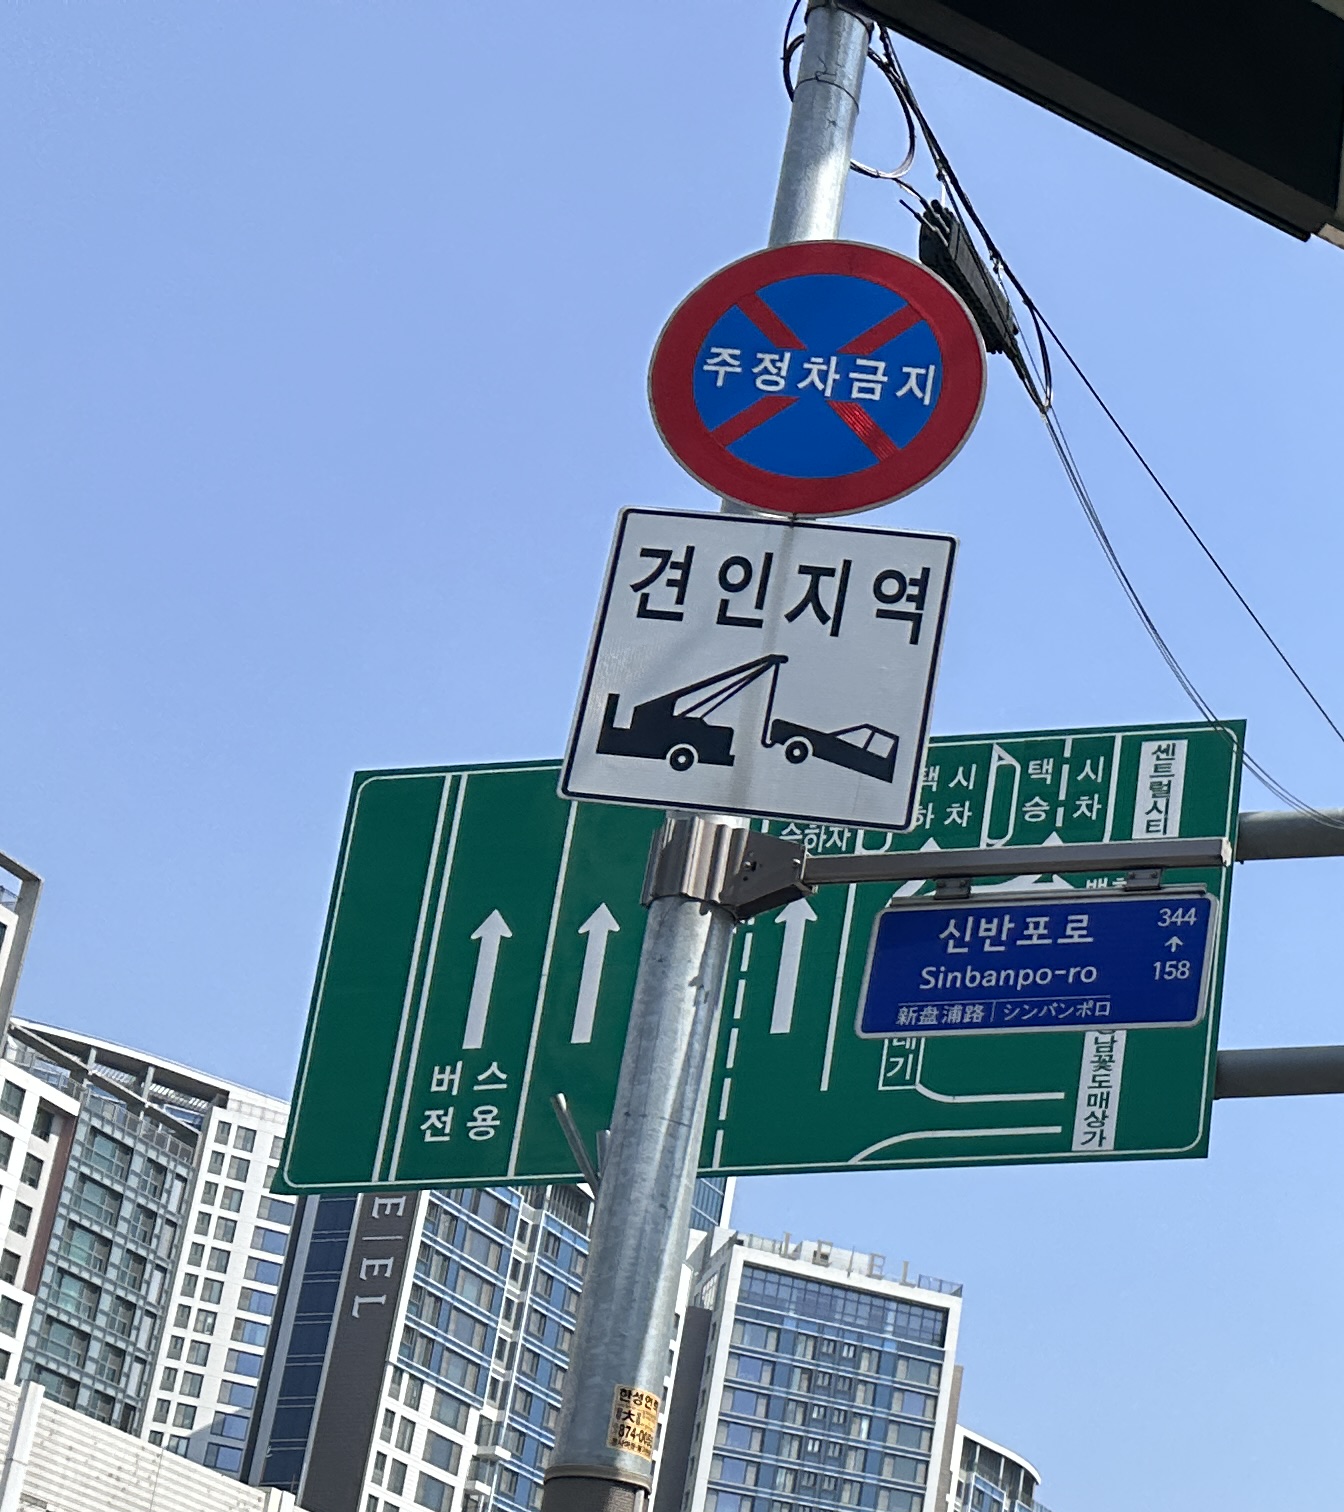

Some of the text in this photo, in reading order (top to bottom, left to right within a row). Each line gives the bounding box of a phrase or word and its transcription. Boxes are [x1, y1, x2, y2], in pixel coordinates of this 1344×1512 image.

[703, 345, 938, 406] 주정차금지
[630, 545, 931, 645] 견인지역
[1144, 742, 1177, 836] 센트럴시티
[938, 913, 1095, 955] 신반포로
[1157, 907, 1197, 928] 344
[920, 965, 1098, 991] Sinbanpo-ro
[1152, 960, 1191, 981] 158
[430, 1060, 509, 1096] 버스
[1081, 1029, 1117, 1148] 남꽃도매상가
[420, 1105, 501, 1142] 전용
